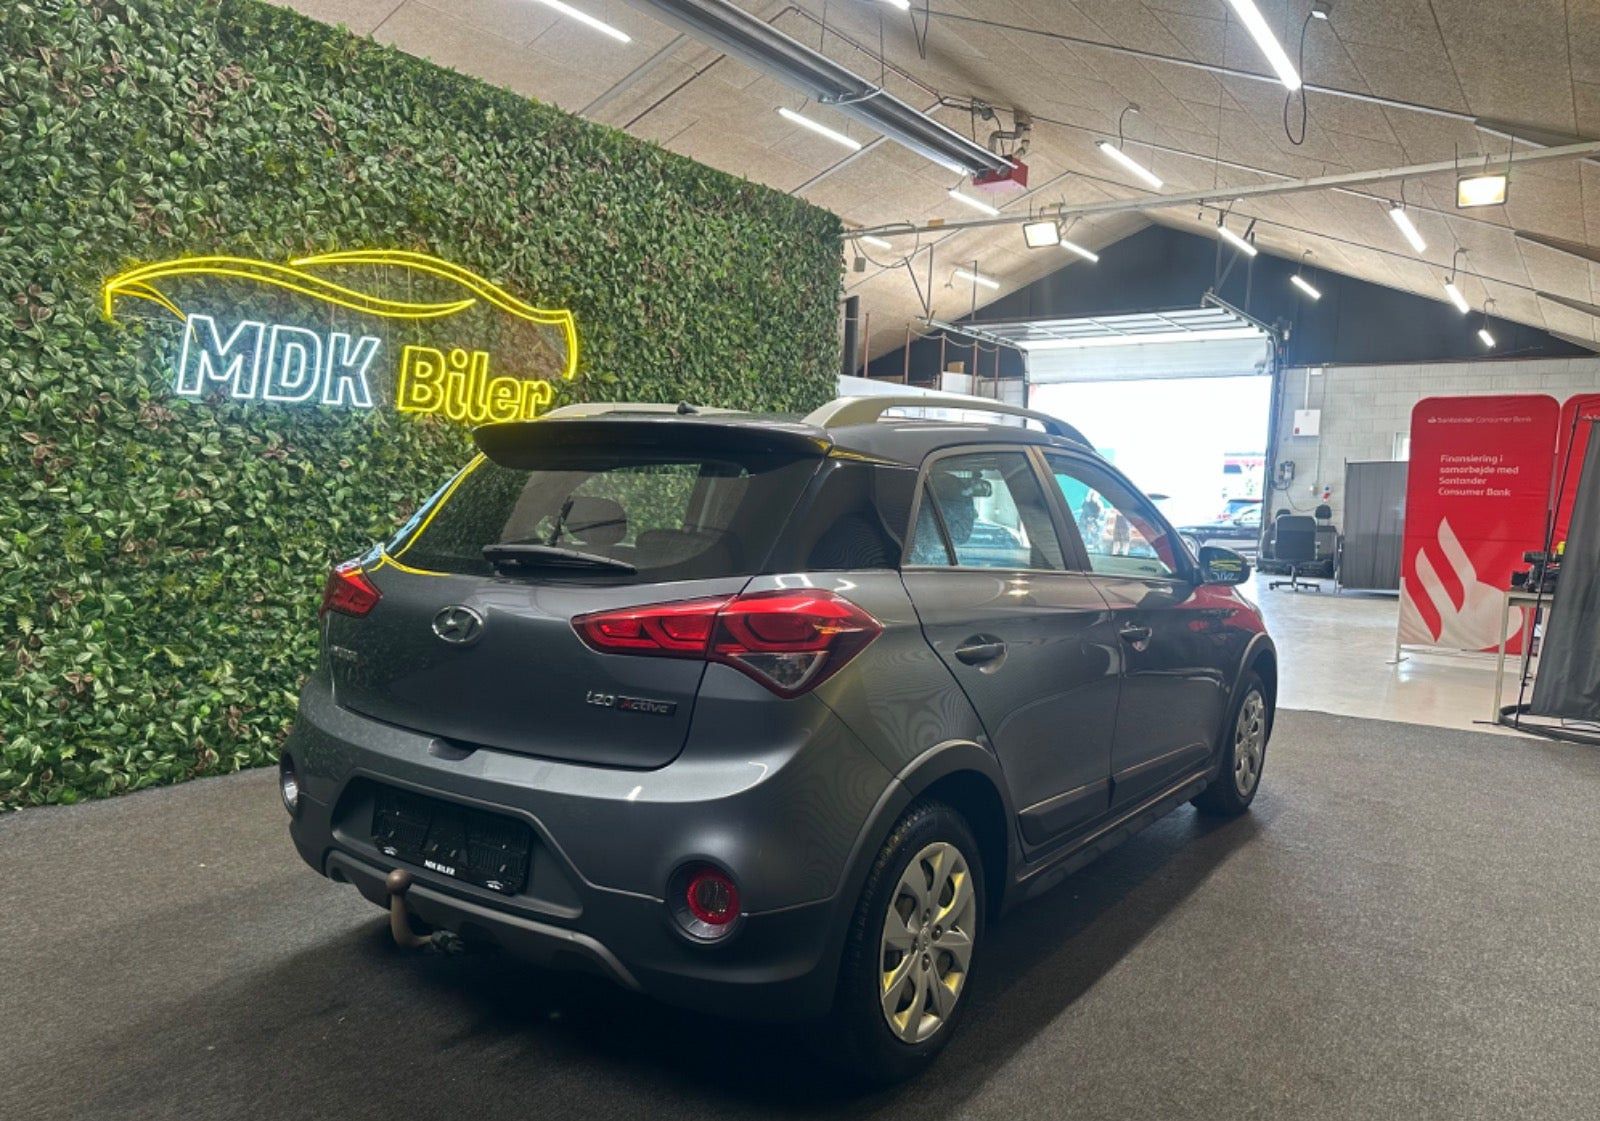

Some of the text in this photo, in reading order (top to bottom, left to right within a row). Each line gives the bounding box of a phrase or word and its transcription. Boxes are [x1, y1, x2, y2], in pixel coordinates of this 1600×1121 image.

[176, 313, 552, 421] MDK Biler
[1437, 416, 1474, 424] Santander
[1475, 416, 1512, 424] Consumer
[1440, 454, 1503, 464] Finansiering i
[1440, 466, 1519, 475] samarbejde med
[1438, 487, 1512, 496] Consumer Bank
